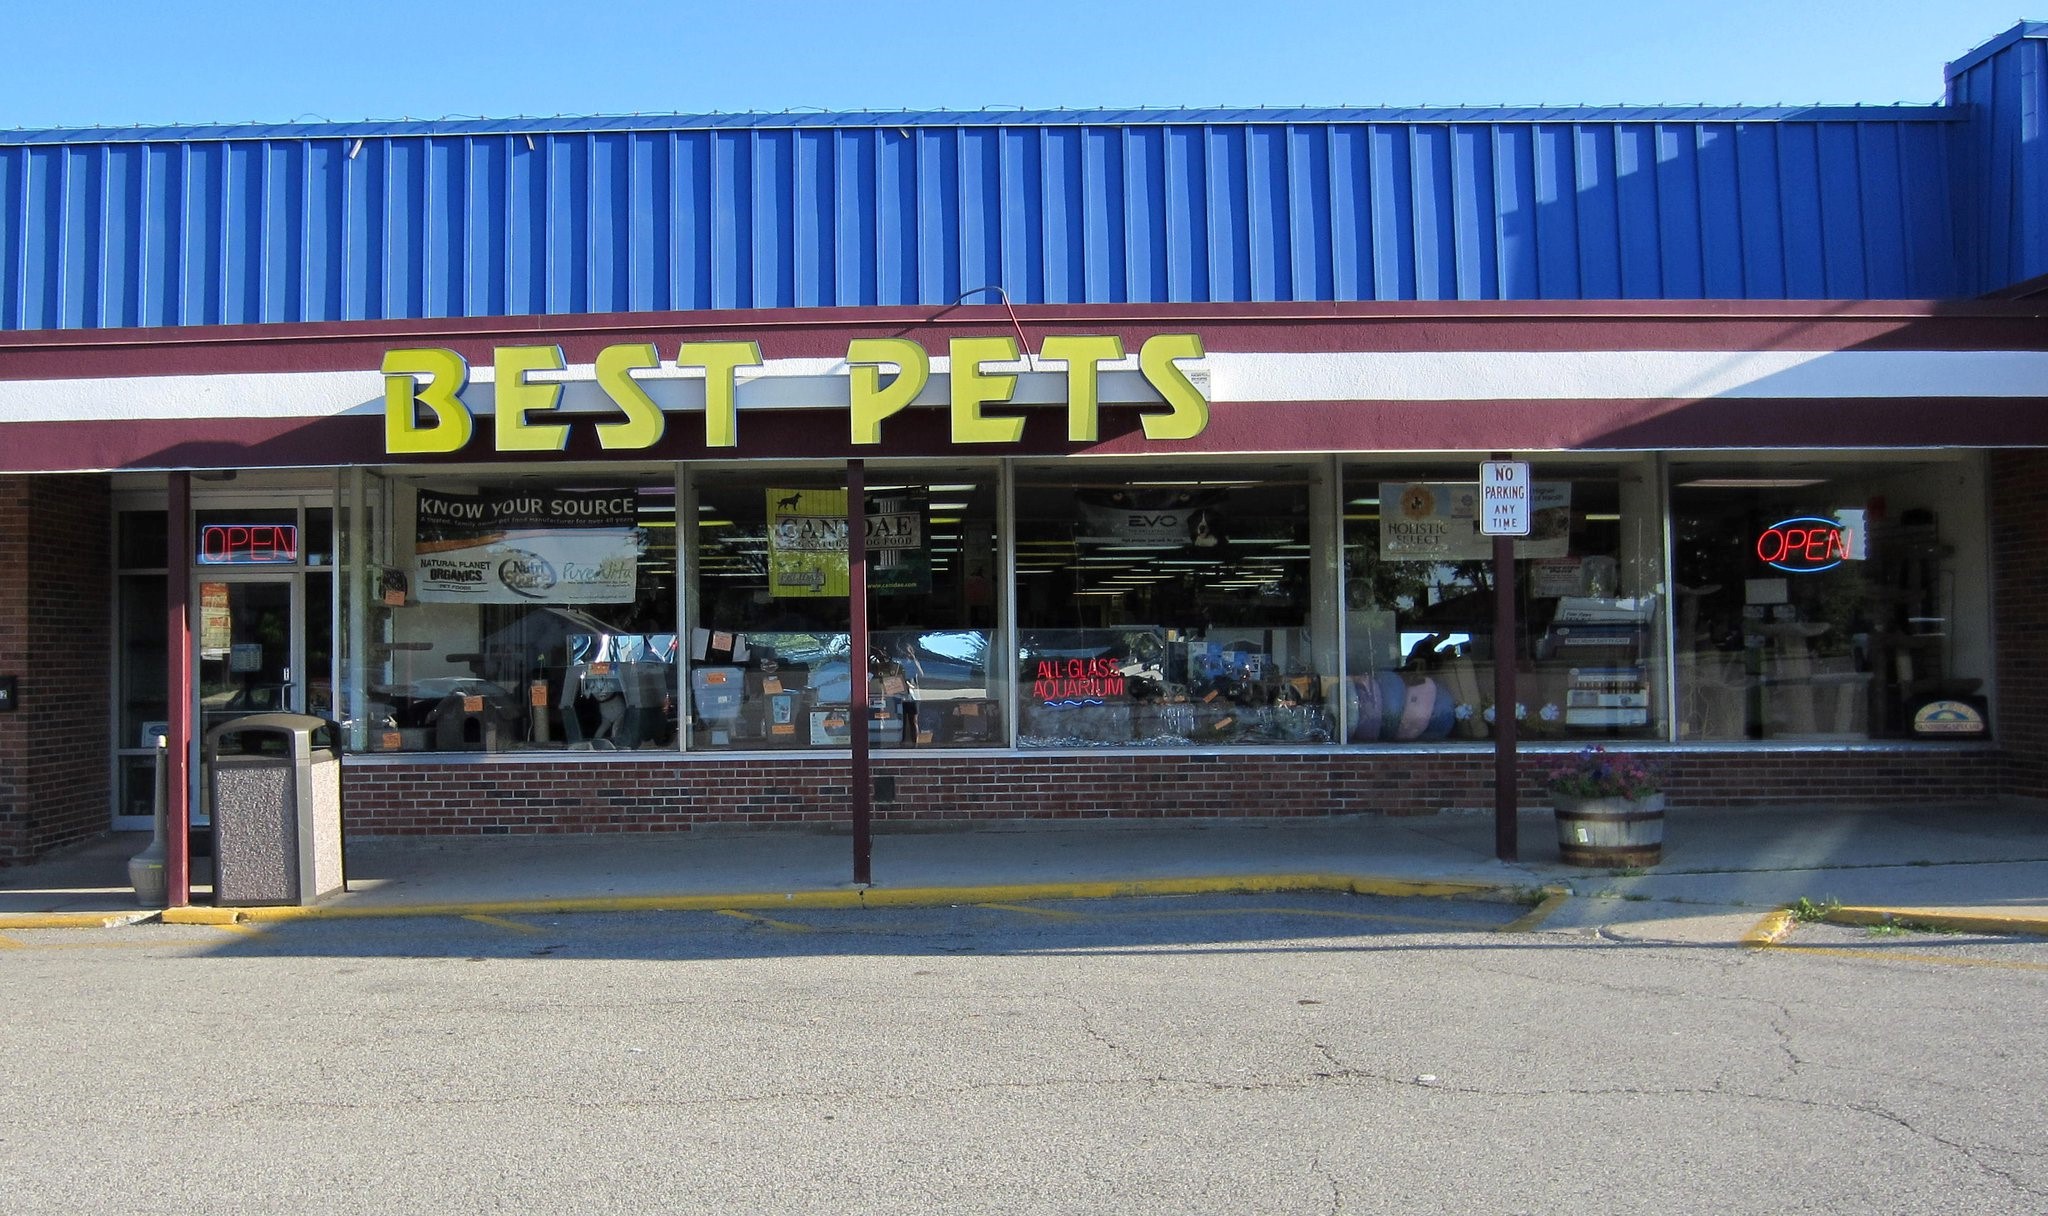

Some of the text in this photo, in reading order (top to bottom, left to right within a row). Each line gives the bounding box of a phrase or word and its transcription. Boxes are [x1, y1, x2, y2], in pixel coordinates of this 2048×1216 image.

[380, 333, 1209, 454] BEST PETS
[1495, 467, 1513, 481] NO
[1485, 485, 1525, 500] PARKING
[421, 497, 635, 519] KNOW YOUR SOURCE
[1494, 504, 1516, 515] ANY
[778, 516, 912, 540] CANAE
[1128, 515, 1177, 527] EVO
[1493, 518, 1517, 528] TIME
[1388, 523, 1448, 535] HOLISTIC
[205, 527, 295, 561] OPEN
[884, 537, 912, 546] FOOD
[1396, 534, 1440, 545] SELECT
[1757, 528, 1853, 561] OPEN
[420, 559, 491, 570] NATURAL PLANET
[430, 568, 483, 582] ORGANICS
[1037, 658, 1121, 679] ALL-GLASS
[1033, 678, 1125, 700] AQUARIUM
